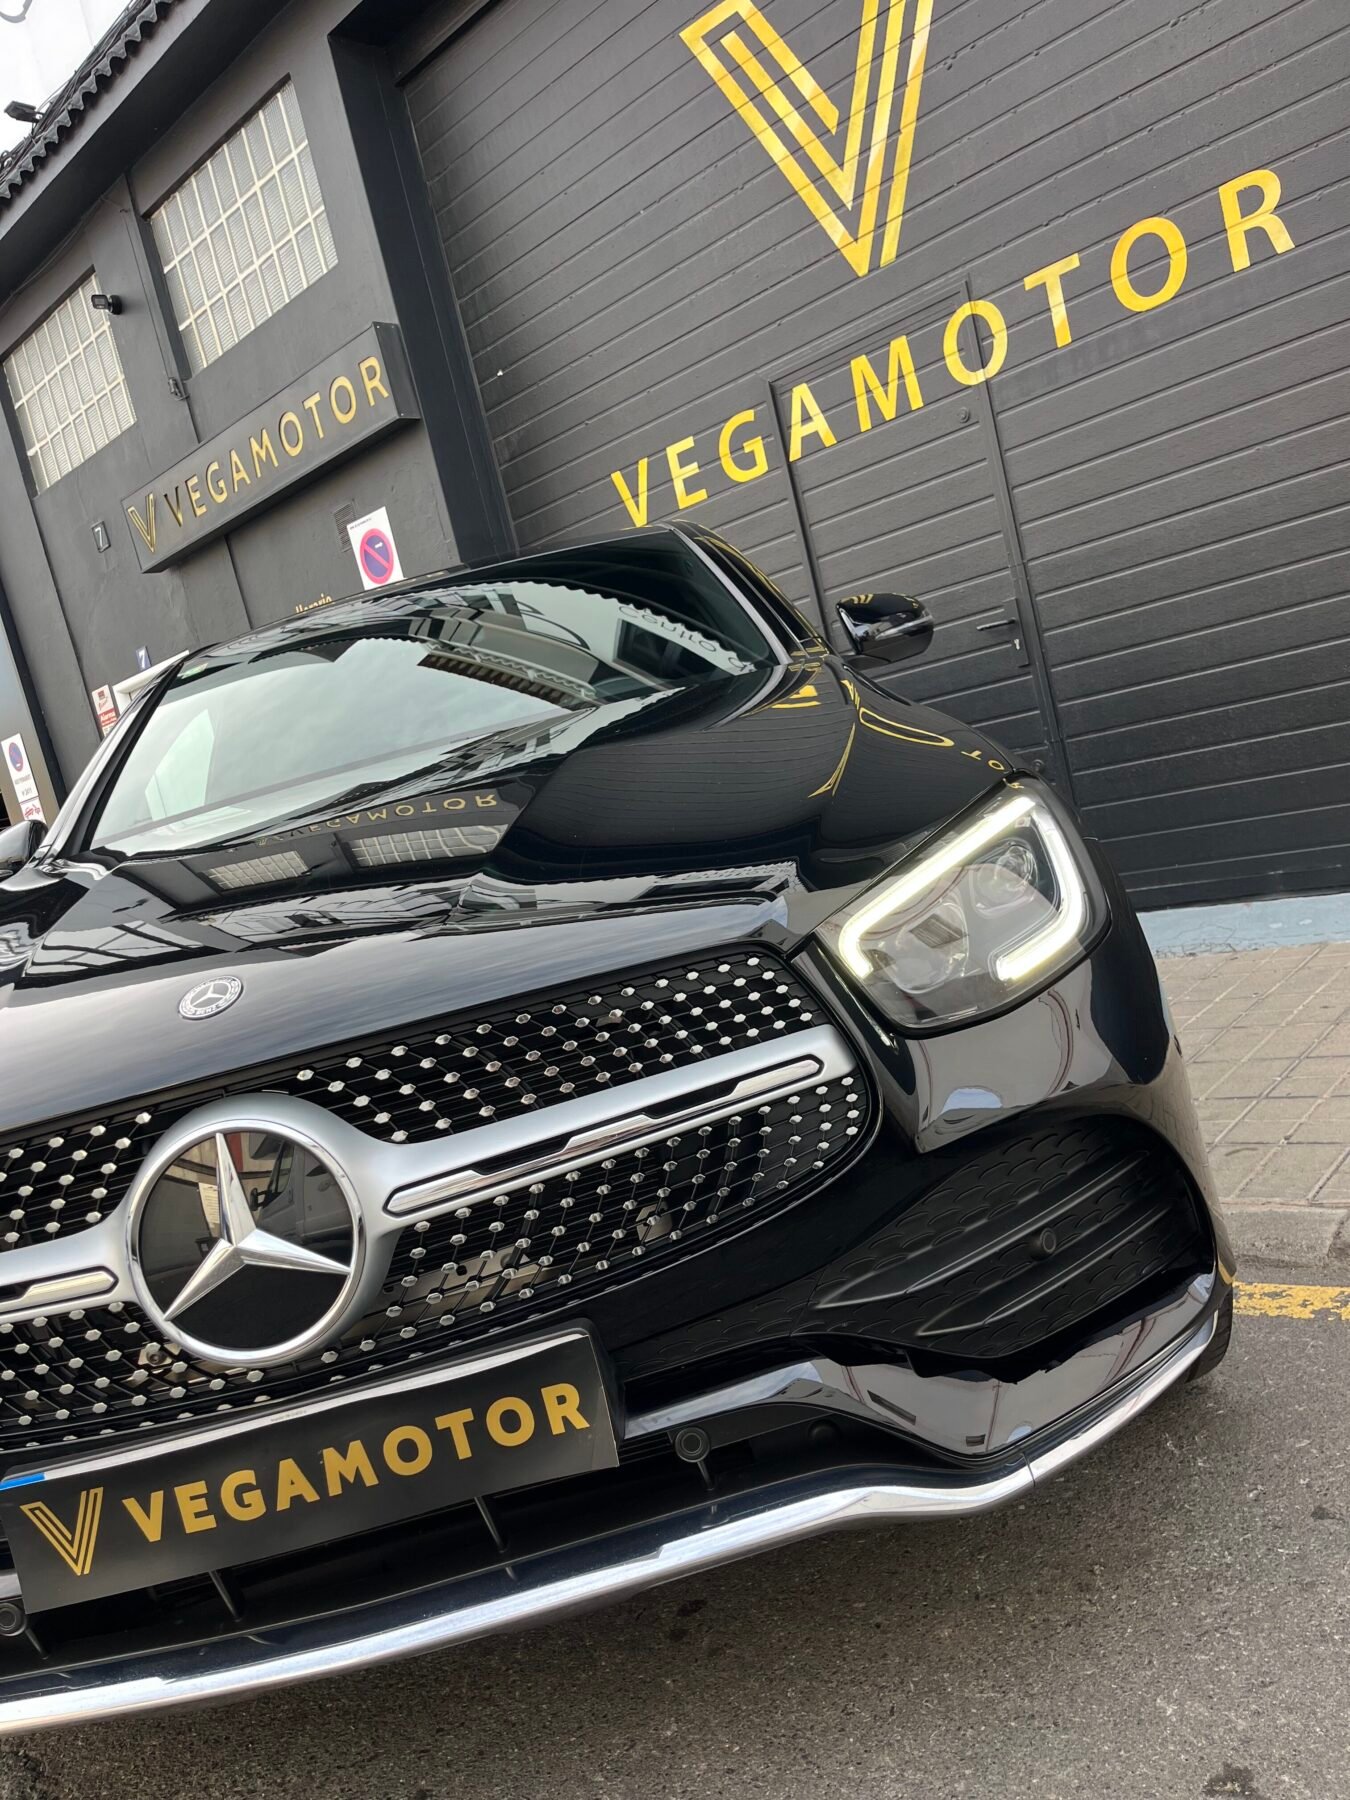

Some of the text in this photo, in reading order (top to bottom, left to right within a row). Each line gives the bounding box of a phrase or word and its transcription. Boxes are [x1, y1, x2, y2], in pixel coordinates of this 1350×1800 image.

[610, 167, 1295, 528] VEGAMOTOR
[163, 355, 390, 528] VEGAMOTOR
[94, 526, 105, 548] 7
[121, 1382, 592, 1543] VEGAMOTOR
